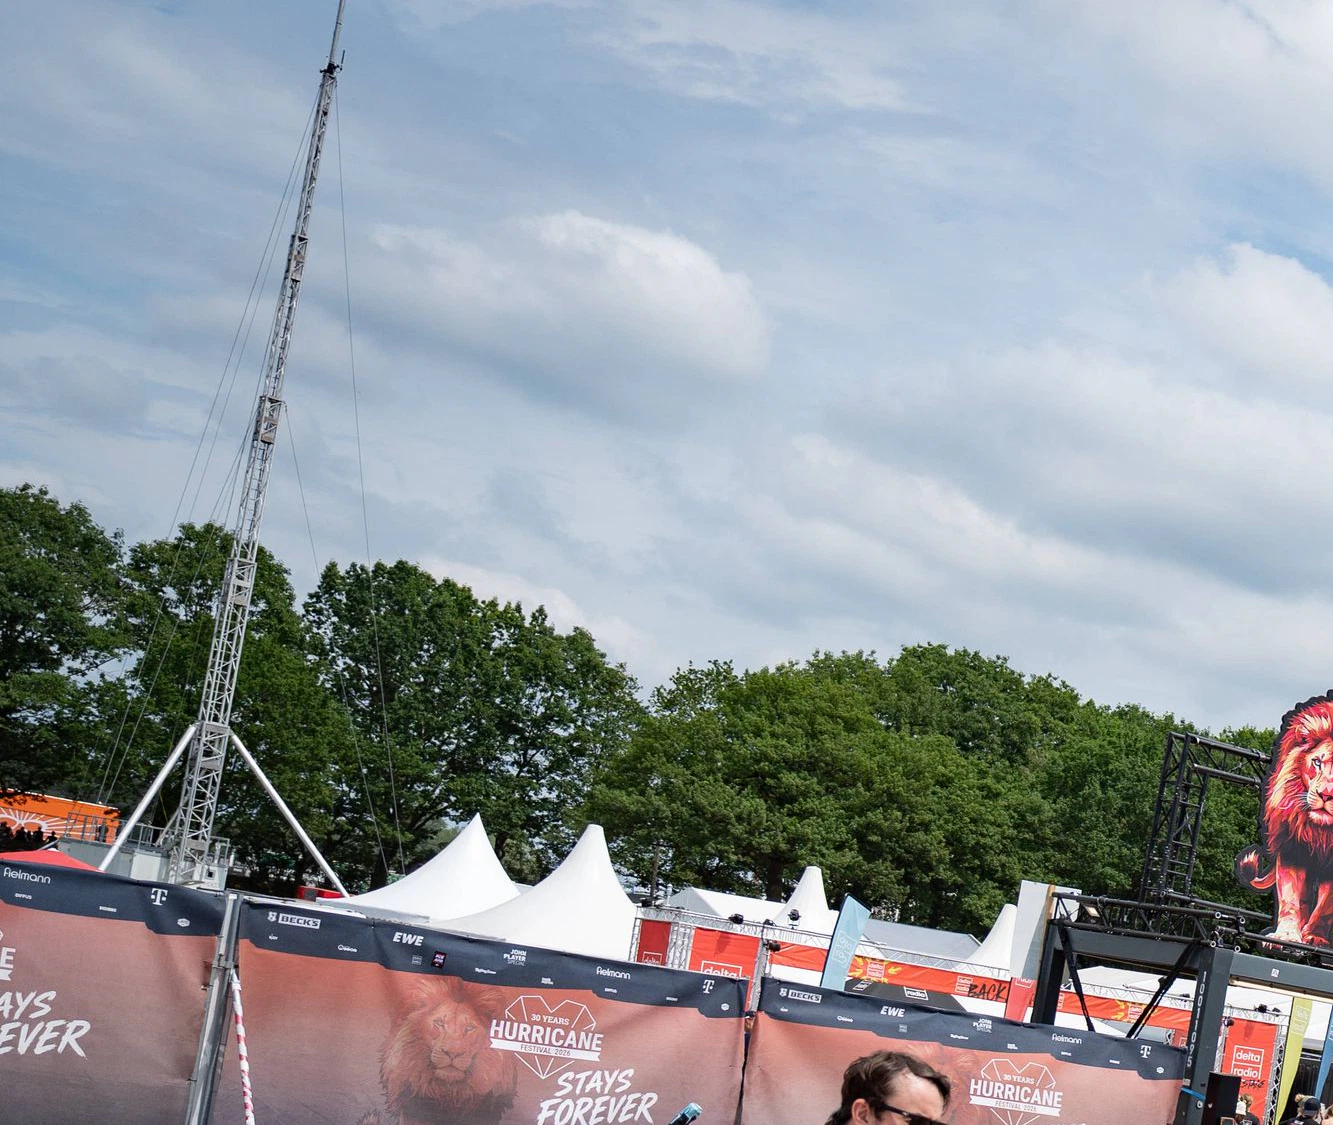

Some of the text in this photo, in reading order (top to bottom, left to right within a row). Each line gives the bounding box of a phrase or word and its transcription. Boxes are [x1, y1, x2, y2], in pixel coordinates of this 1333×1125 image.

[392, 931, 424, 947] EWE
[503, 953, 526, 962] PLAYER
[907, 989, 926, 998] radio
[880, 1005, 905, 1018] EWE
[530, 1013, 570, 1026] 30 YEARS
[489, 1019, 604, 1051] HURRICANE
[520, 1044, 572, 1057] FESTIVAL 2026
[1235, 1050, 1261, 1062] delta
[1233, 1067, 1258, 1078] radio
[554, 1068, 635, 1098] STAYS
[1013, 1075, 1035, 1085] YEARS
[969, 1078, 1064, 1108] HURRICANE
[994, 1100, 1022, 1110] FESTIVAL
